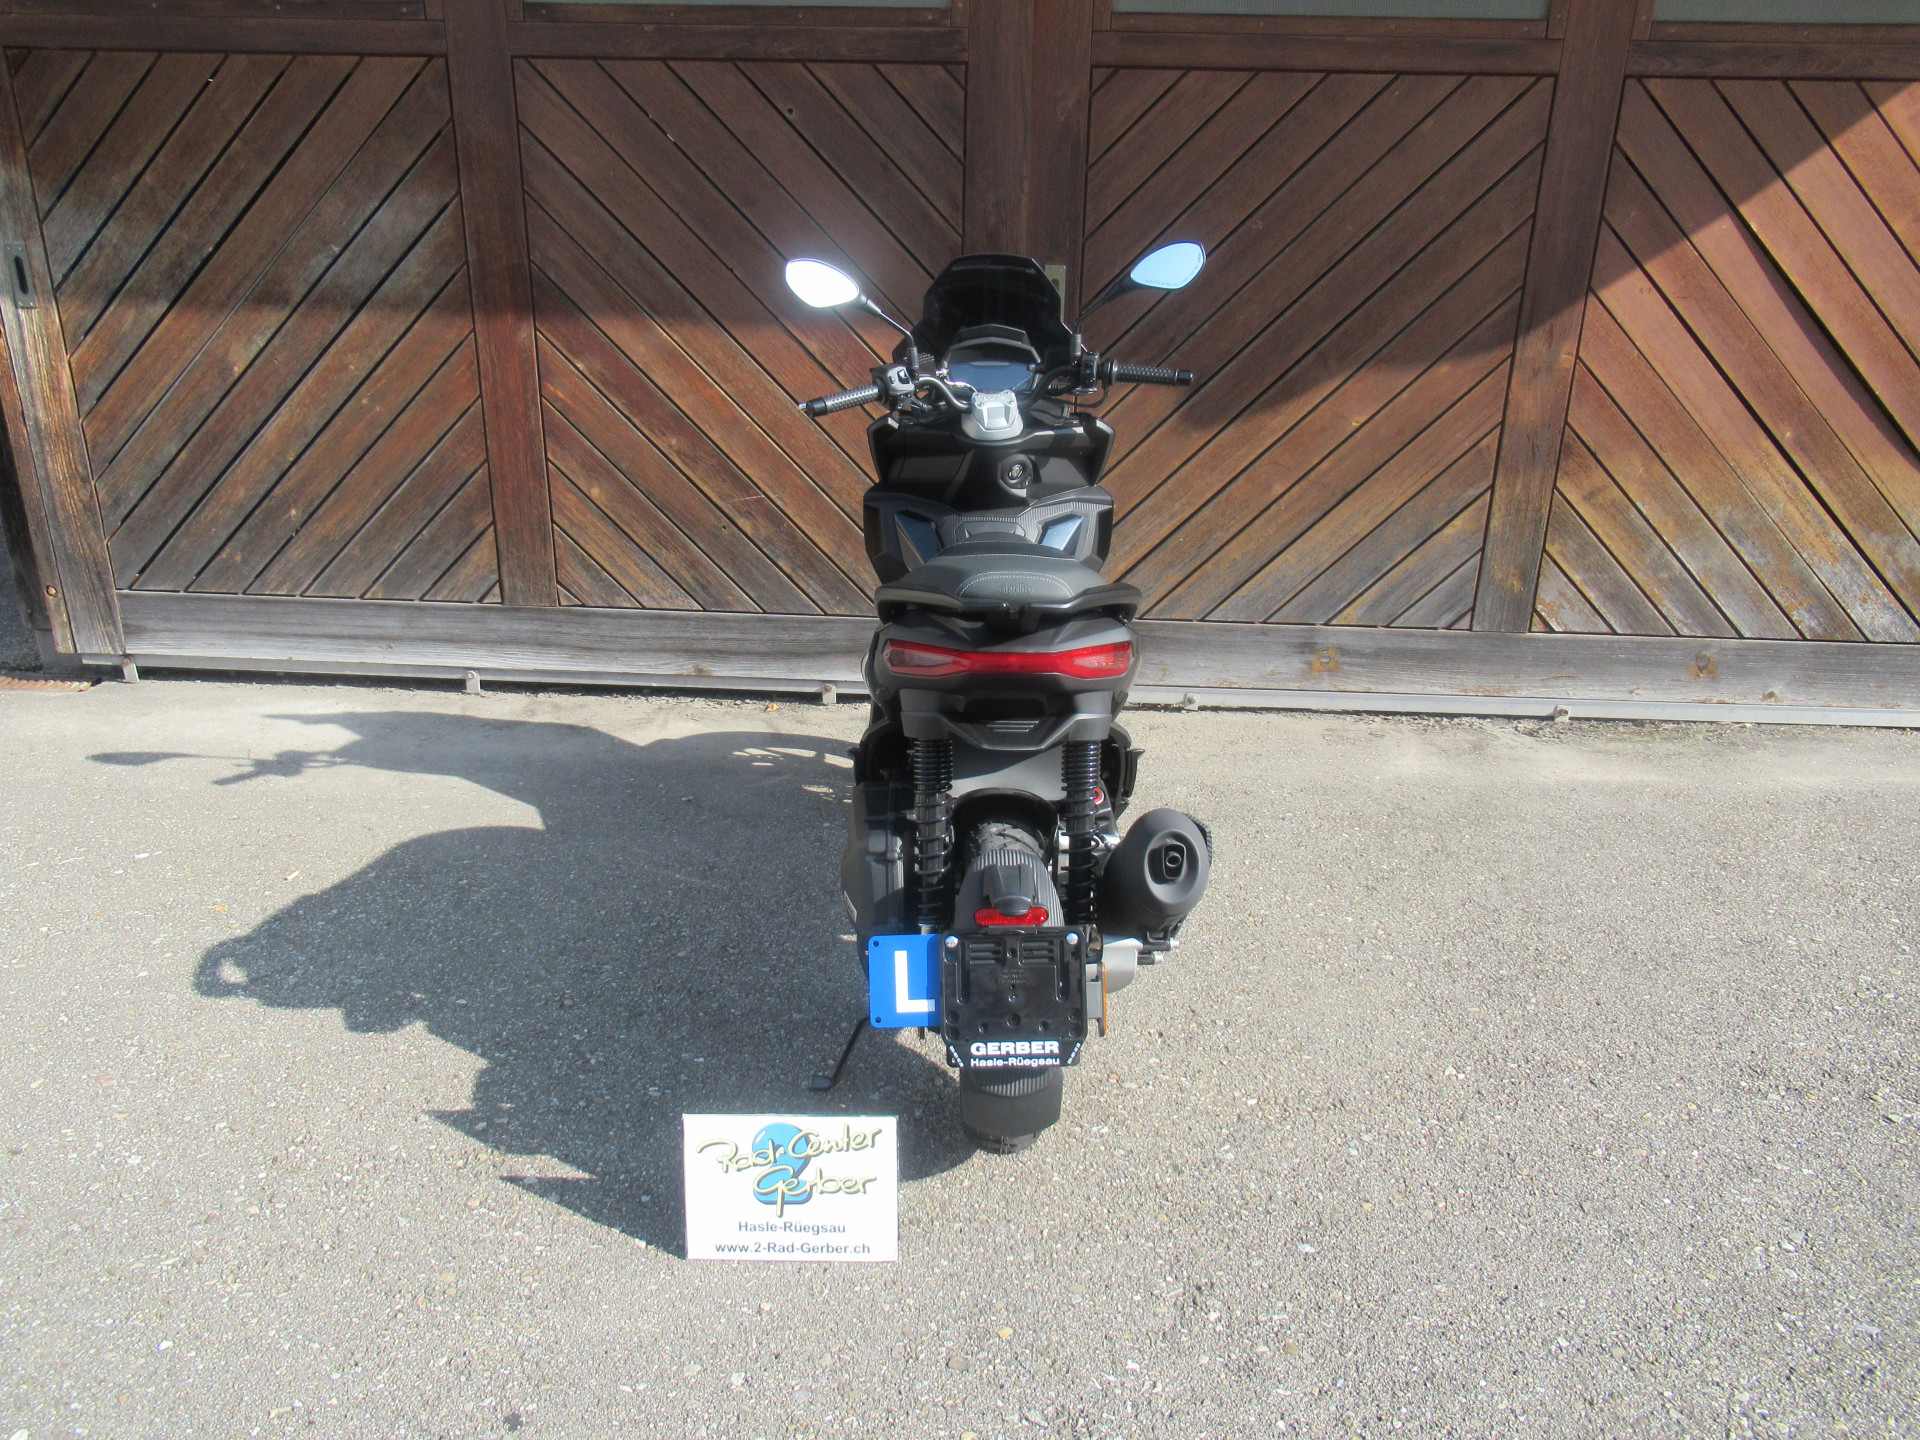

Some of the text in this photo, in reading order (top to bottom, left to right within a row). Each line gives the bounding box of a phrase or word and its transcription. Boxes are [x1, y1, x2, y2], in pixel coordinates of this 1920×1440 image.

[894, 950, 936, 1014] L
[970, 1040, 1060, 1056] GERBER
[970, 1057, 1060, 1068] Hasle-Rüegsau
[753, 1165, 877, 1218] Gerber
[738, 1221, 846, 1235] Hasle-Rüegsau
[715, 1242, 870, 1254] www.2-Rad-Gerber.ch
